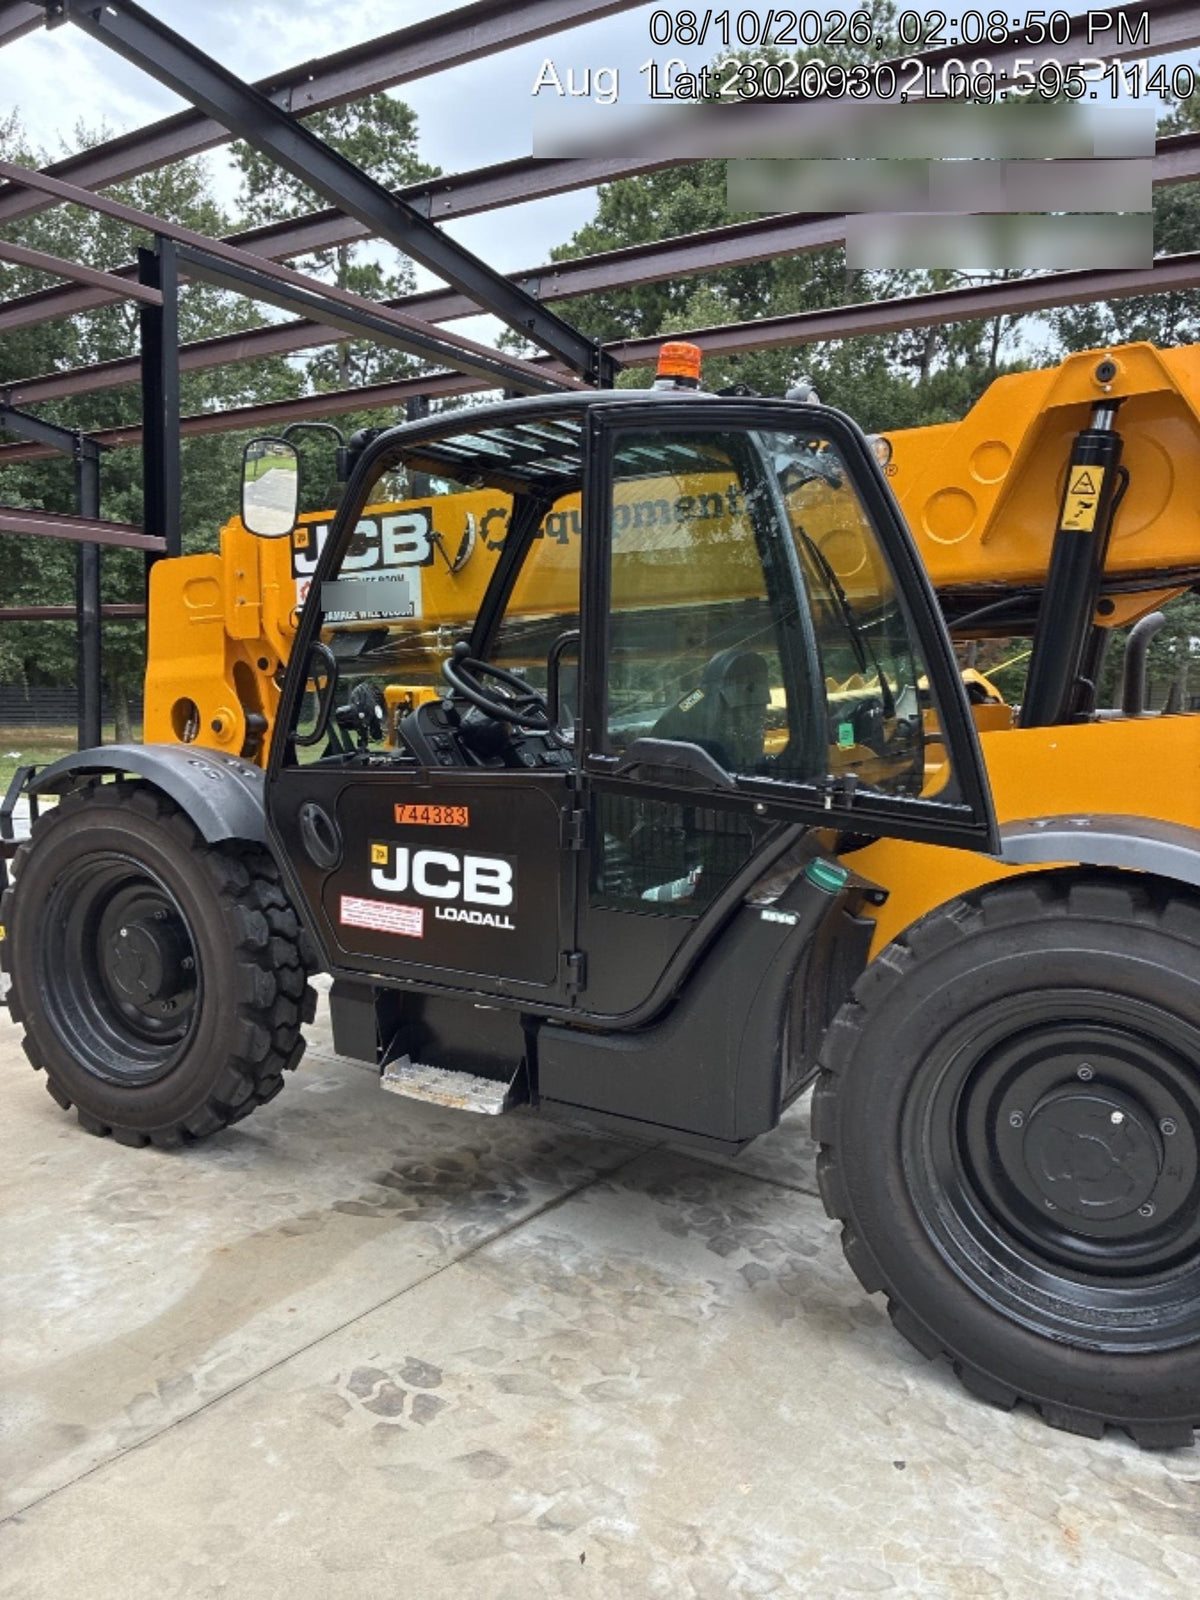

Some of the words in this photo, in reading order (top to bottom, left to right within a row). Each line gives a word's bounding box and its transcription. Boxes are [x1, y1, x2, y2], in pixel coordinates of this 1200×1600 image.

[294, 513, 431, 573] JCB
[397, 804, 467, 826] 744383
[371, 847, 513, 906] JCB
[435, 906, 516, 930] LOADALL
